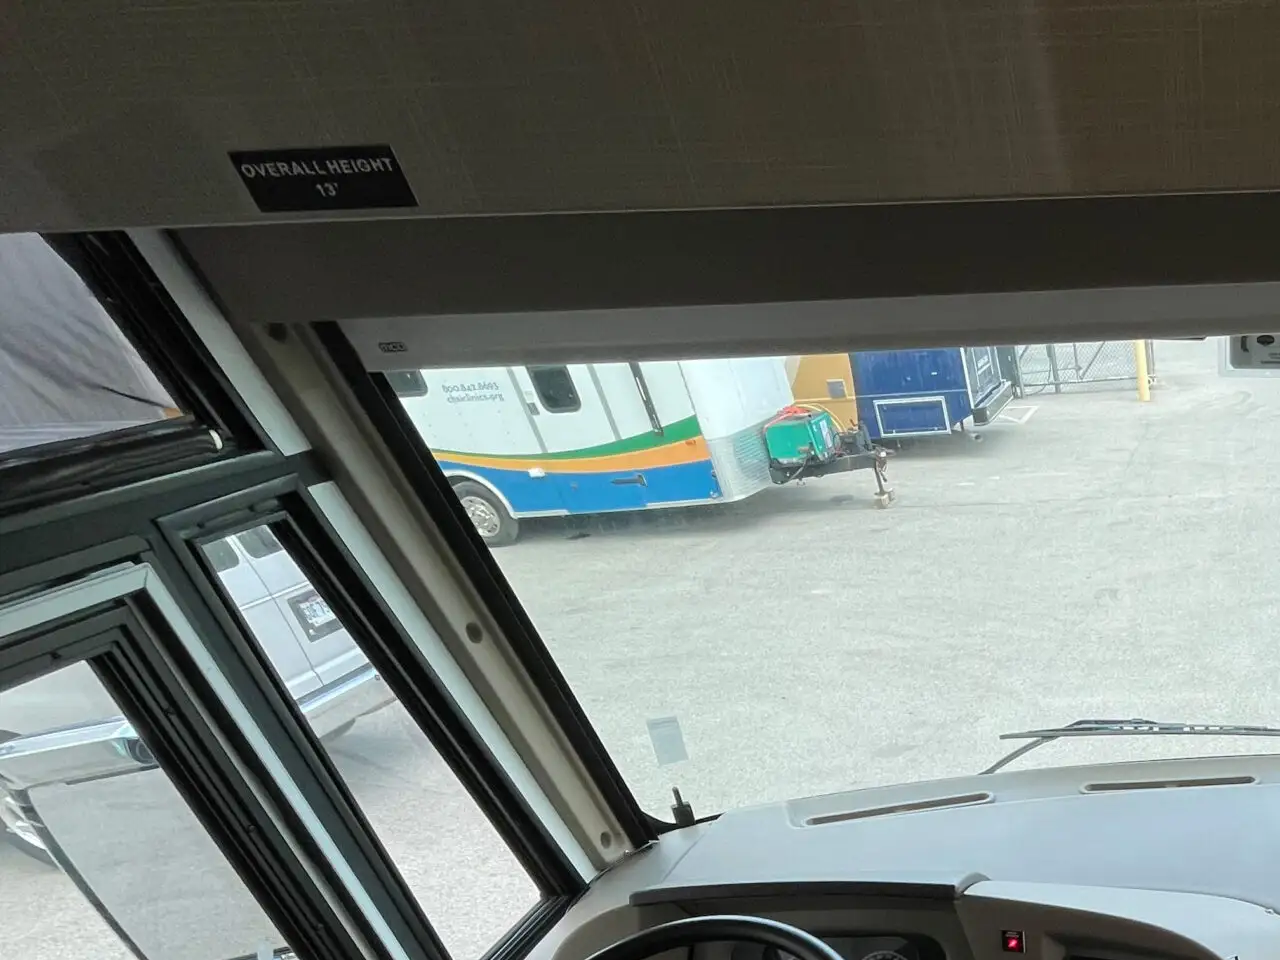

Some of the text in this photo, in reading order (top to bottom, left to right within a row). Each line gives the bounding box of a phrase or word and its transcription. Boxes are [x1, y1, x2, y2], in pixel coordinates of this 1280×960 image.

[241, 157, 393, 178] OVERALL HEIGHT
[315, 182, 339, 197] 13'
